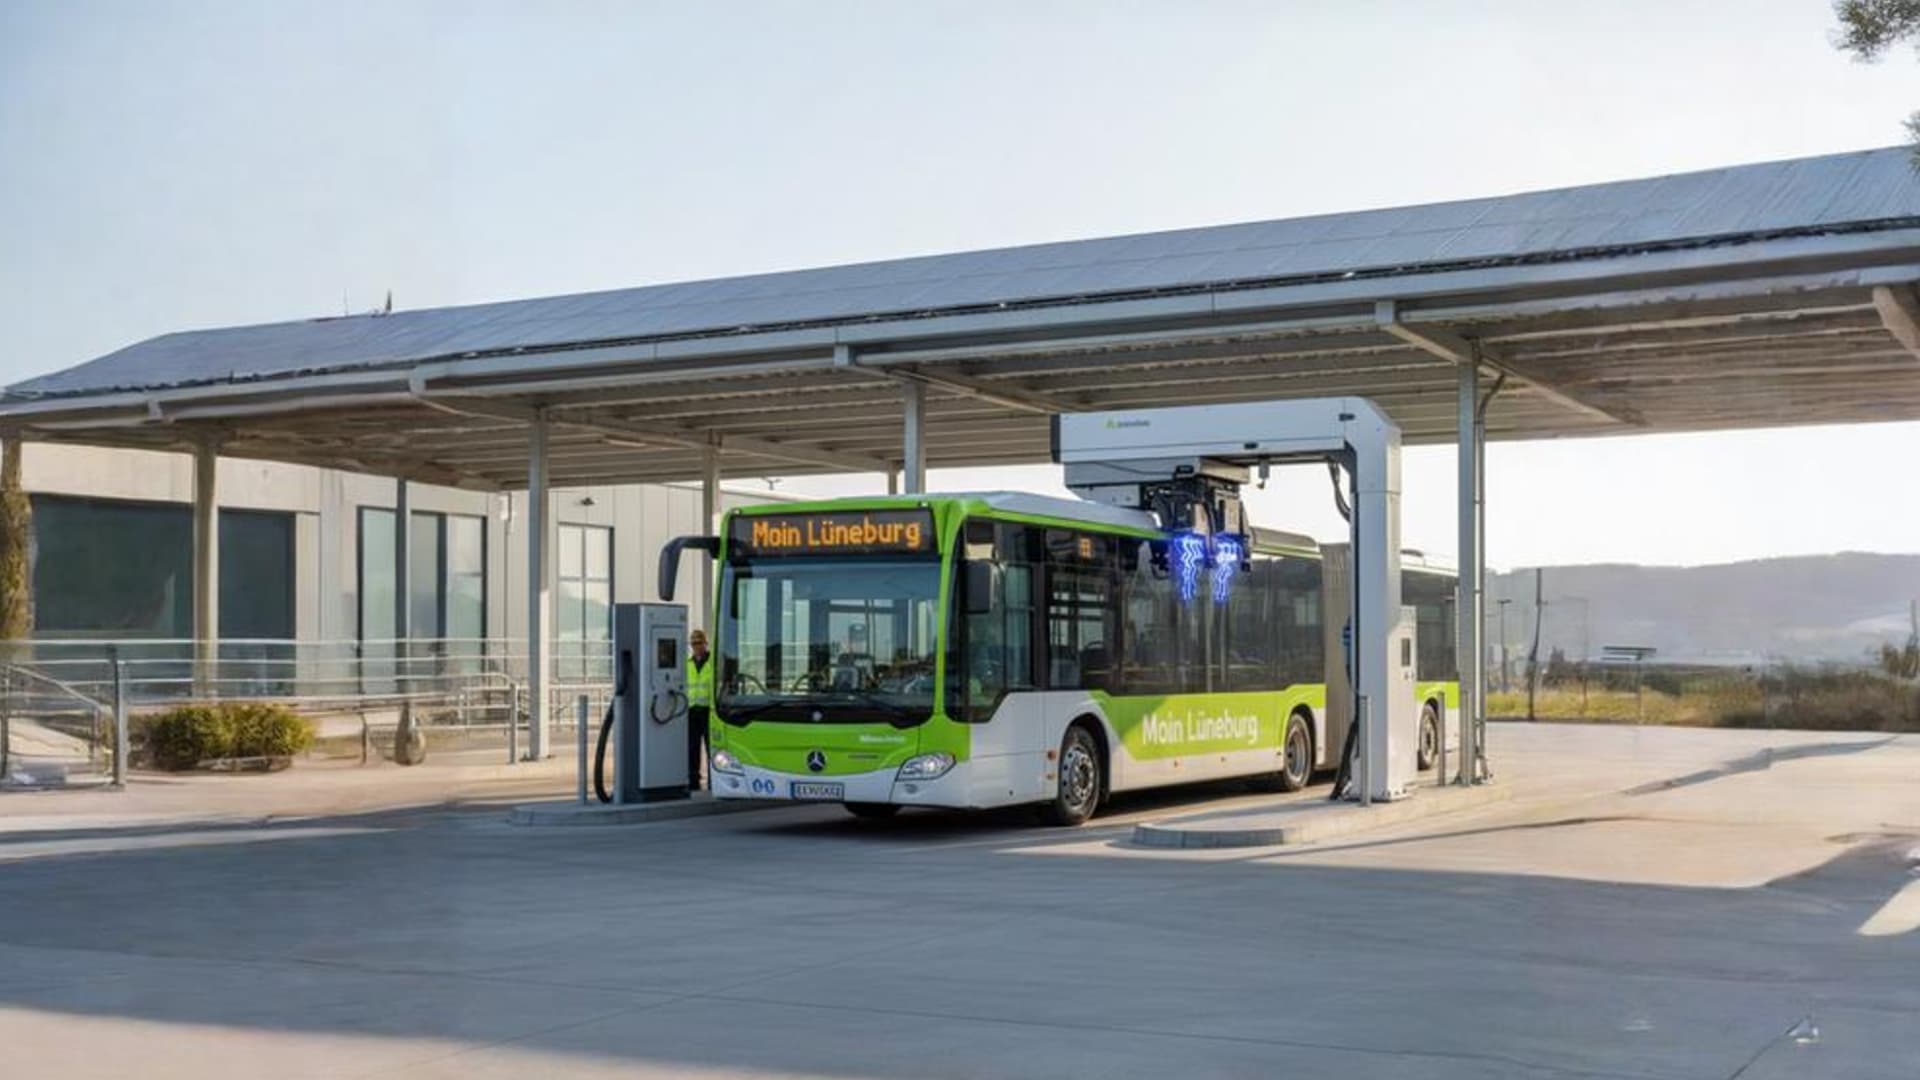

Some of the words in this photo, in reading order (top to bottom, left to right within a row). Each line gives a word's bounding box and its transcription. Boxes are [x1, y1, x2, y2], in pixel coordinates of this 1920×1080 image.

[752, 520, 801, 547] Moin
[807, 515, 921, 549] Lüneburg
[1142, 711, 1184, 745] Moin
[1187, 708, 1258, 745] Lüneburg
